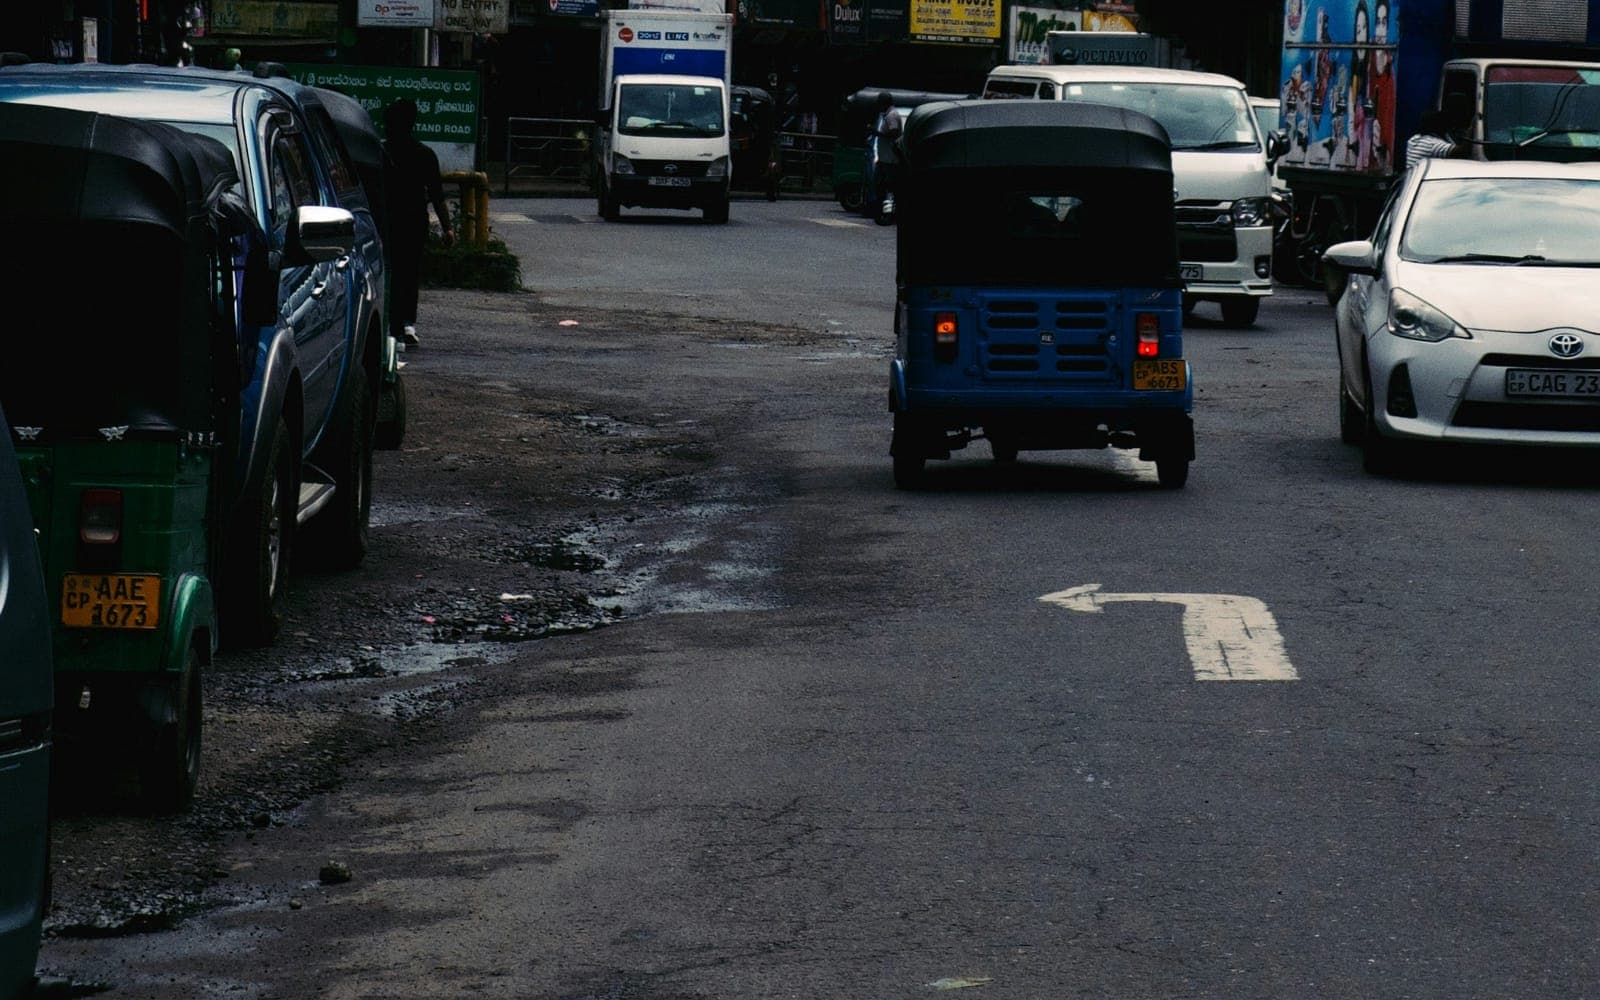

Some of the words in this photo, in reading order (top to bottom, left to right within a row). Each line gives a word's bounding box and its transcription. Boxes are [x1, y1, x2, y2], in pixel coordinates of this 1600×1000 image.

[462, 0, 498, 10] ENTRY
[835, 4, 860, 21] Dulux
[446, 17, 467, 26] ONE
[473, 17, 491, 28] WAY
[412, 123, 440, 133] TAND
[444, 124, 471, 134] ROAD
[1510, 382, 1525, 392] CP
[1529, 374, 1566, 392] CAG
[66, 592, 90, 608] CP
[97, 577, 145, 600] AAE
